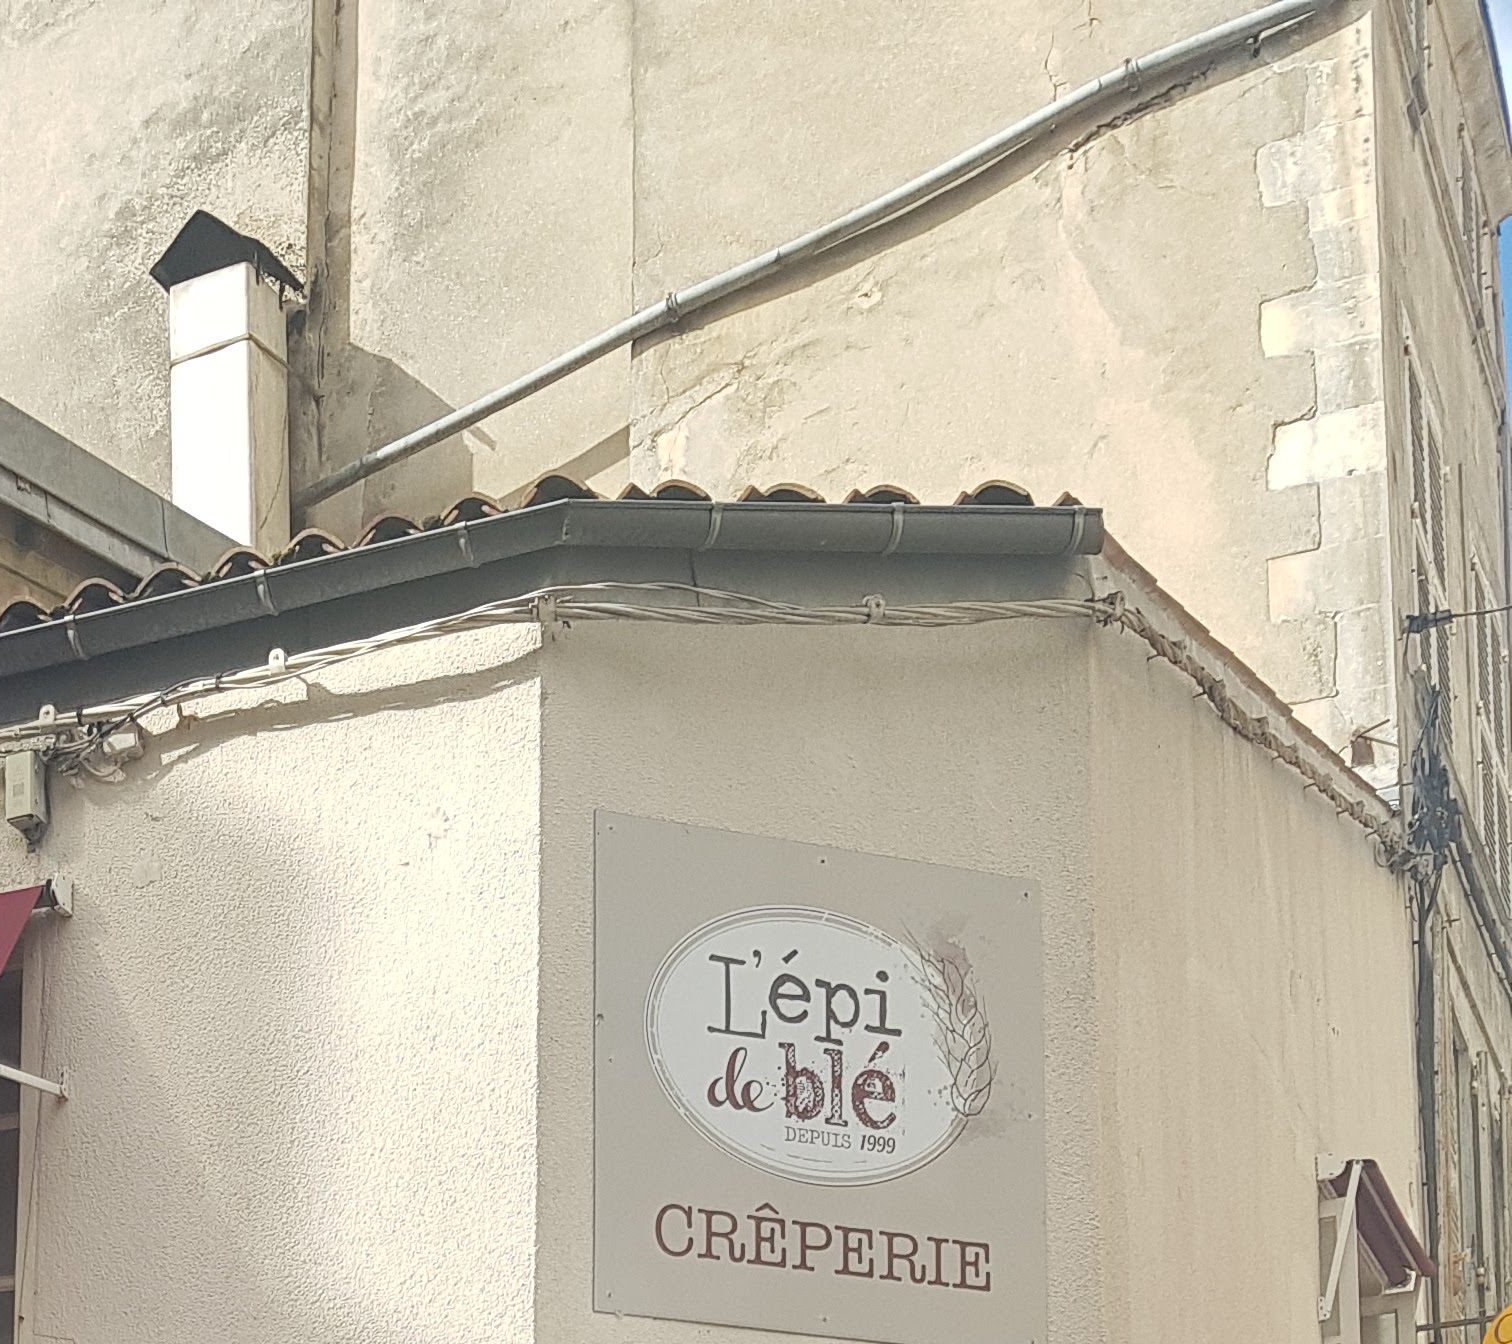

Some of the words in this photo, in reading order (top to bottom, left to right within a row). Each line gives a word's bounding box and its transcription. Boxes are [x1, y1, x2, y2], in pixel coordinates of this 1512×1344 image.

[706, 949, 903, 1047] L'épi
[707, 1046, 775, 1113] de
[777, 1040, 898, 1131] blé
[784, 1125, 852, 1150] DEPUIS
[859, 1133, 897, 1155] 1999
[654, 1202, 993, 1293] CRÊPERIE
